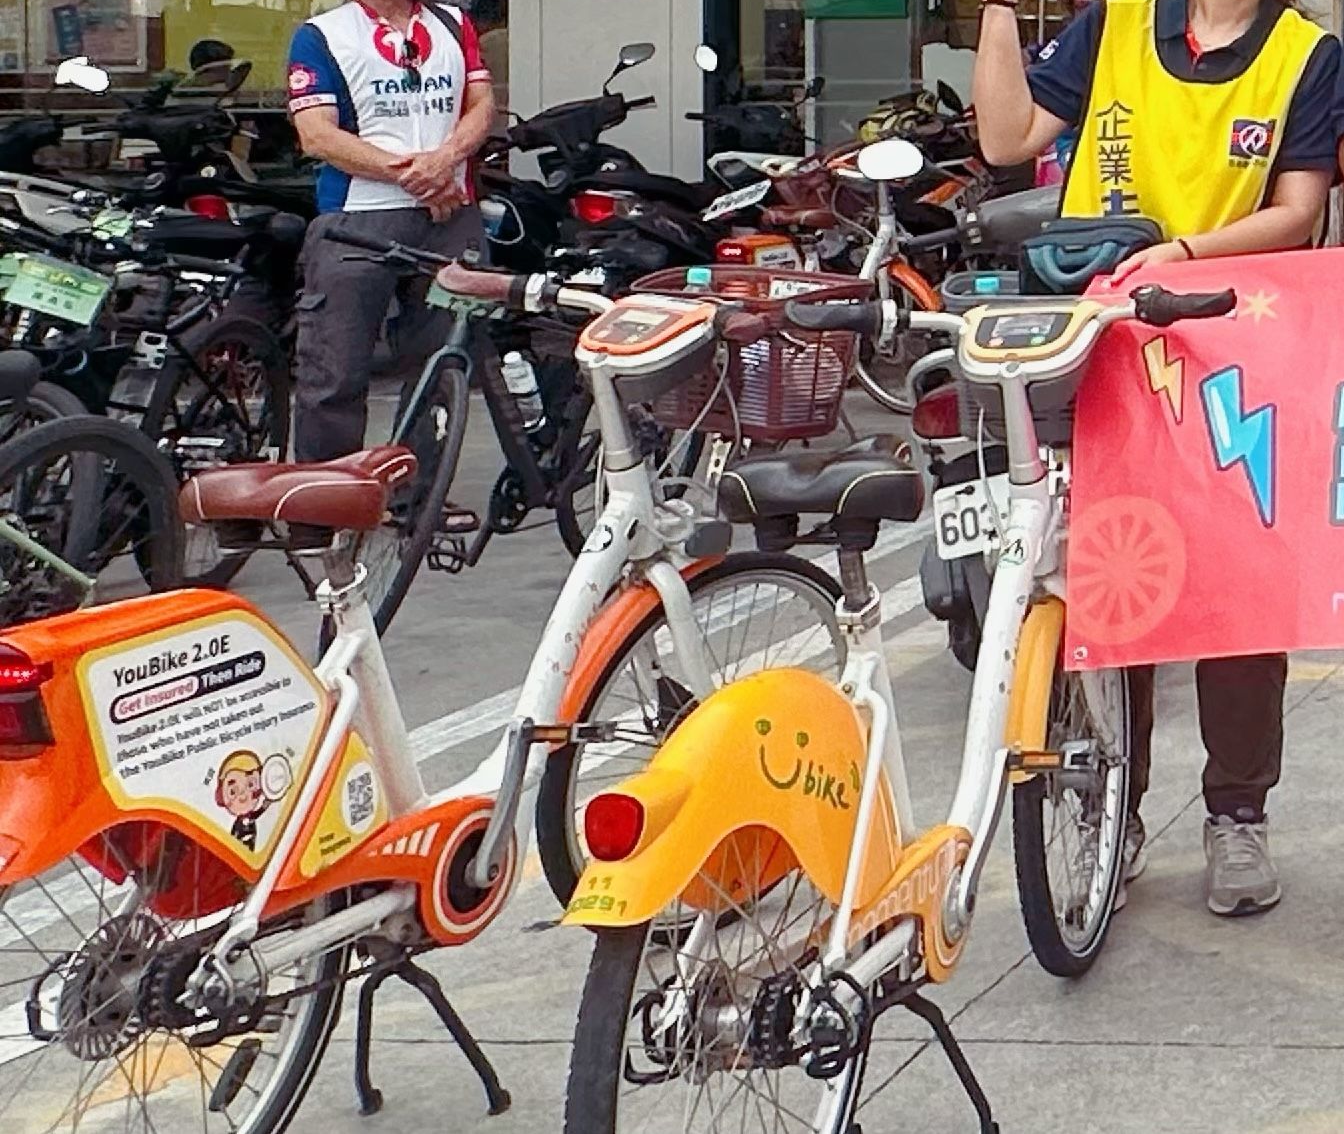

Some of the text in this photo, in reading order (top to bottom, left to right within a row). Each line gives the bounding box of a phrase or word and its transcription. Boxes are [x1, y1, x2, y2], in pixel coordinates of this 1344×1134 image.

[113, 634, 231, 688] YouBike 2.0E
[118, 698, 143, 716] Get
[144, 680, 194, 708] Insured
[202, 668, 234, 688] Then
